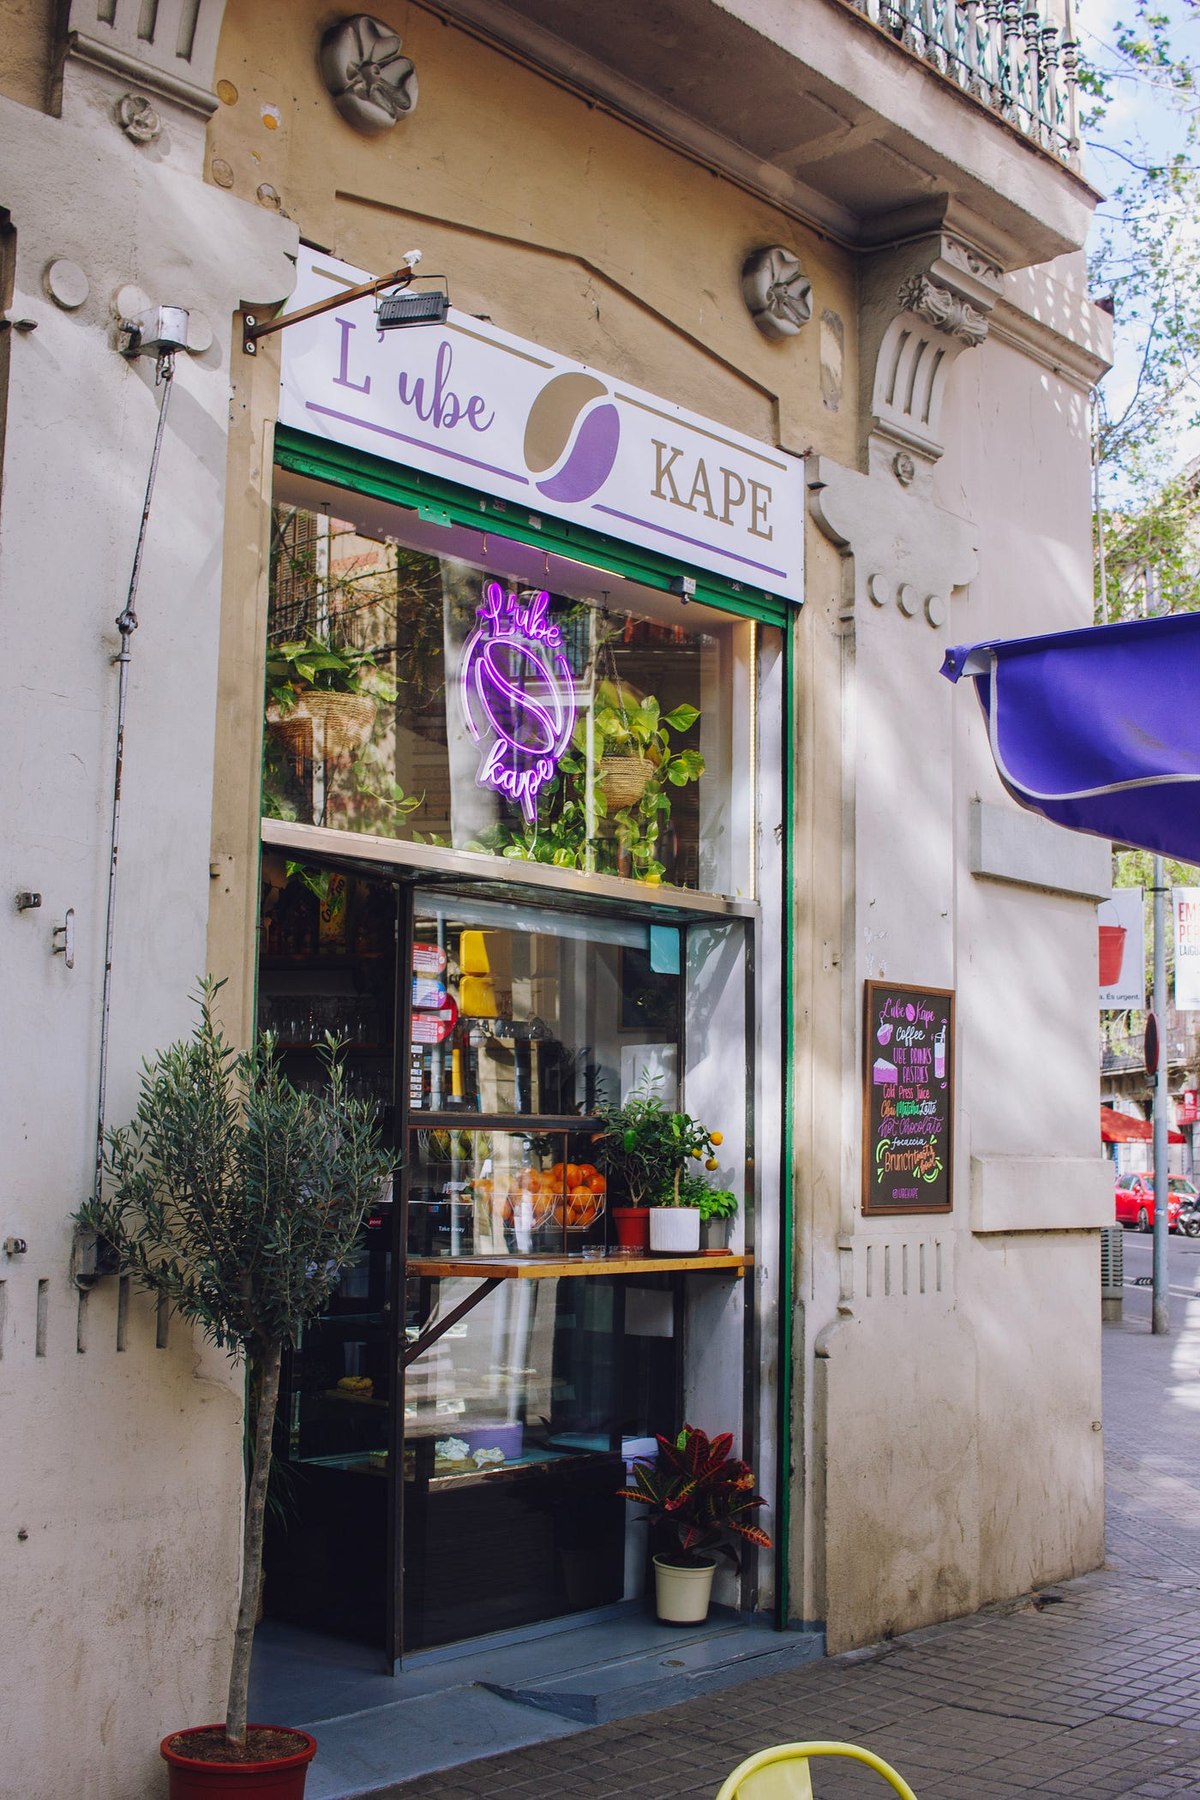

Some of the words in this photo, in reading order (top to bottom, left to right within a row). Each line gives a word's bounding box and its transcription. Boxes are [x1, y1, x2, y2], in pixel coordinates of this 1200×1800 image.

[650, 438, 773, 541] KAPE
[896, 1025, 926, 1047] Coffee
[883, 1084, 896, 1099] Cold
[899, 1085, 914, 1099] Press
[885, 1150, 914, 1173] Brunch
